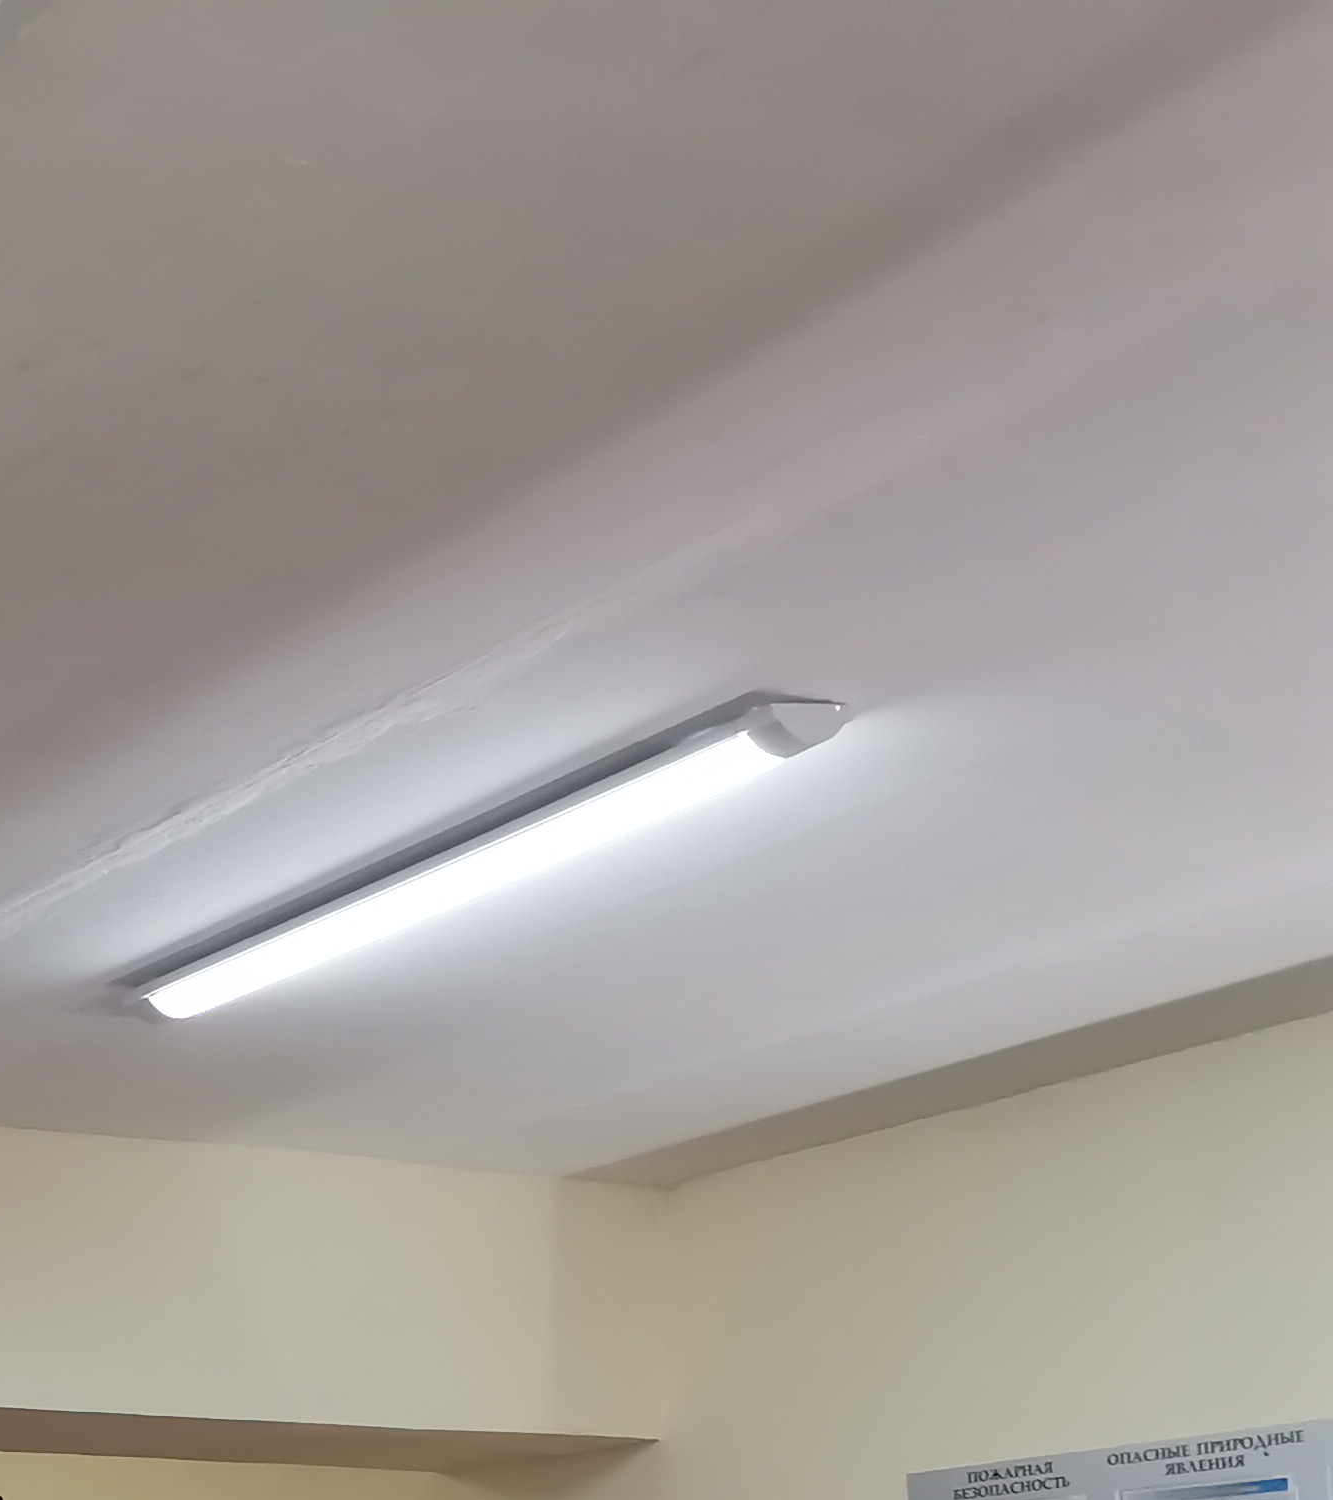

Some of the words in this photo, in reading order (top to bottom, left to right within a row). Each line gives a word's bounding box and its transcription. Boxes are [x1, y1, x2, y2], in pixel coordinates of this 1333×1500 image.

[1107, 1444, 1191, 1466] ОПАСНЫЕ
[1197, 1429, 1305, 1457] ПРИРОДНЫЕ
[967, 1461, 1053, 1483] ПОЖАРНАЯ
[1165, 1454, 1245, 1476] ЯВЛЕНИЯ
[953, 1476, 1070, 1500] БЕЗОПАСНОСТЬ
